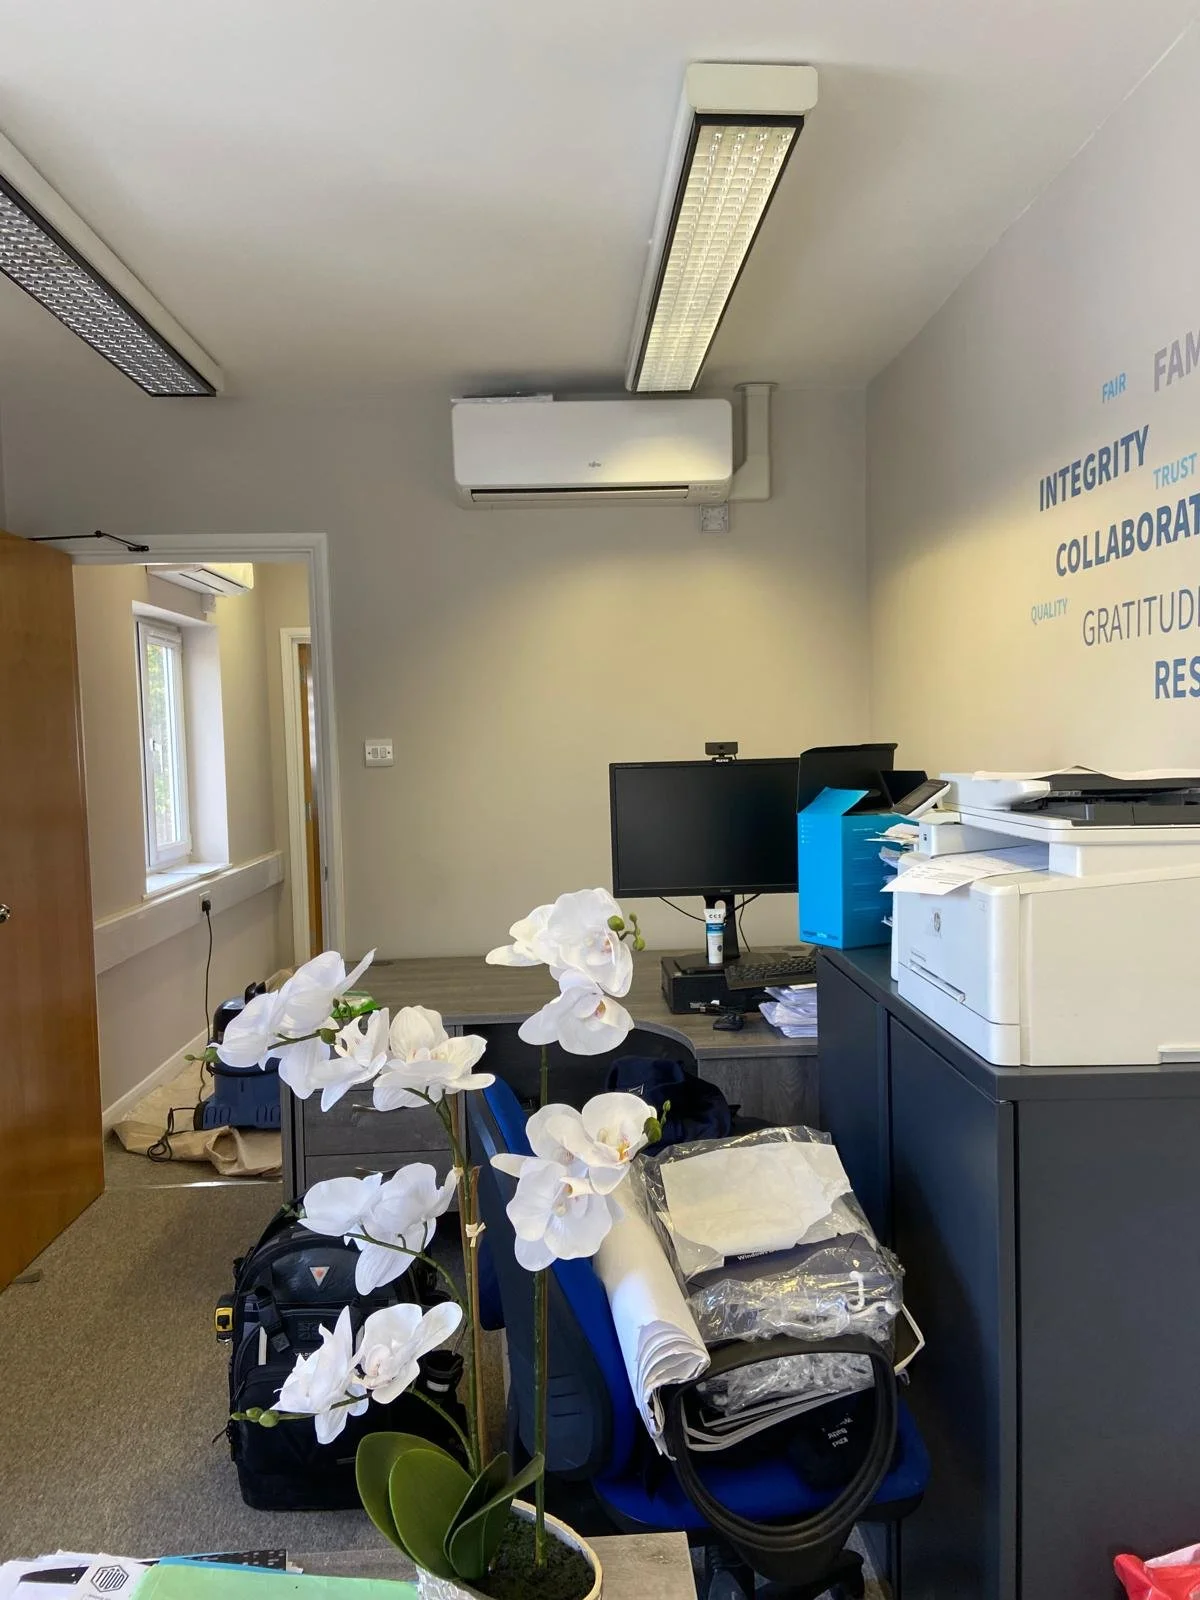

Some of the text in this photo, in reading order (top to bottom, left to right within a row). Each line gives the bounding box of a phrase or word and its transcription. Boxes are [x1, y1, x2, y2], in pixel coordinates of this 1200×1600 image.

[1154, 330, 1200, 392] FAM
[1102, 372, 1126, 403] FAIR
[1039, 424, 1149, 511] INTEGRITY
[1153, 453, 1197, 489] TRUST
[1056, 493, 1200, 576] COLLABORAT
[1031, 597, 1068, 625] QUALITY
[1082, 586, 1200, 646] GRATITUD
[1155, 656, 1200, 698] RES
